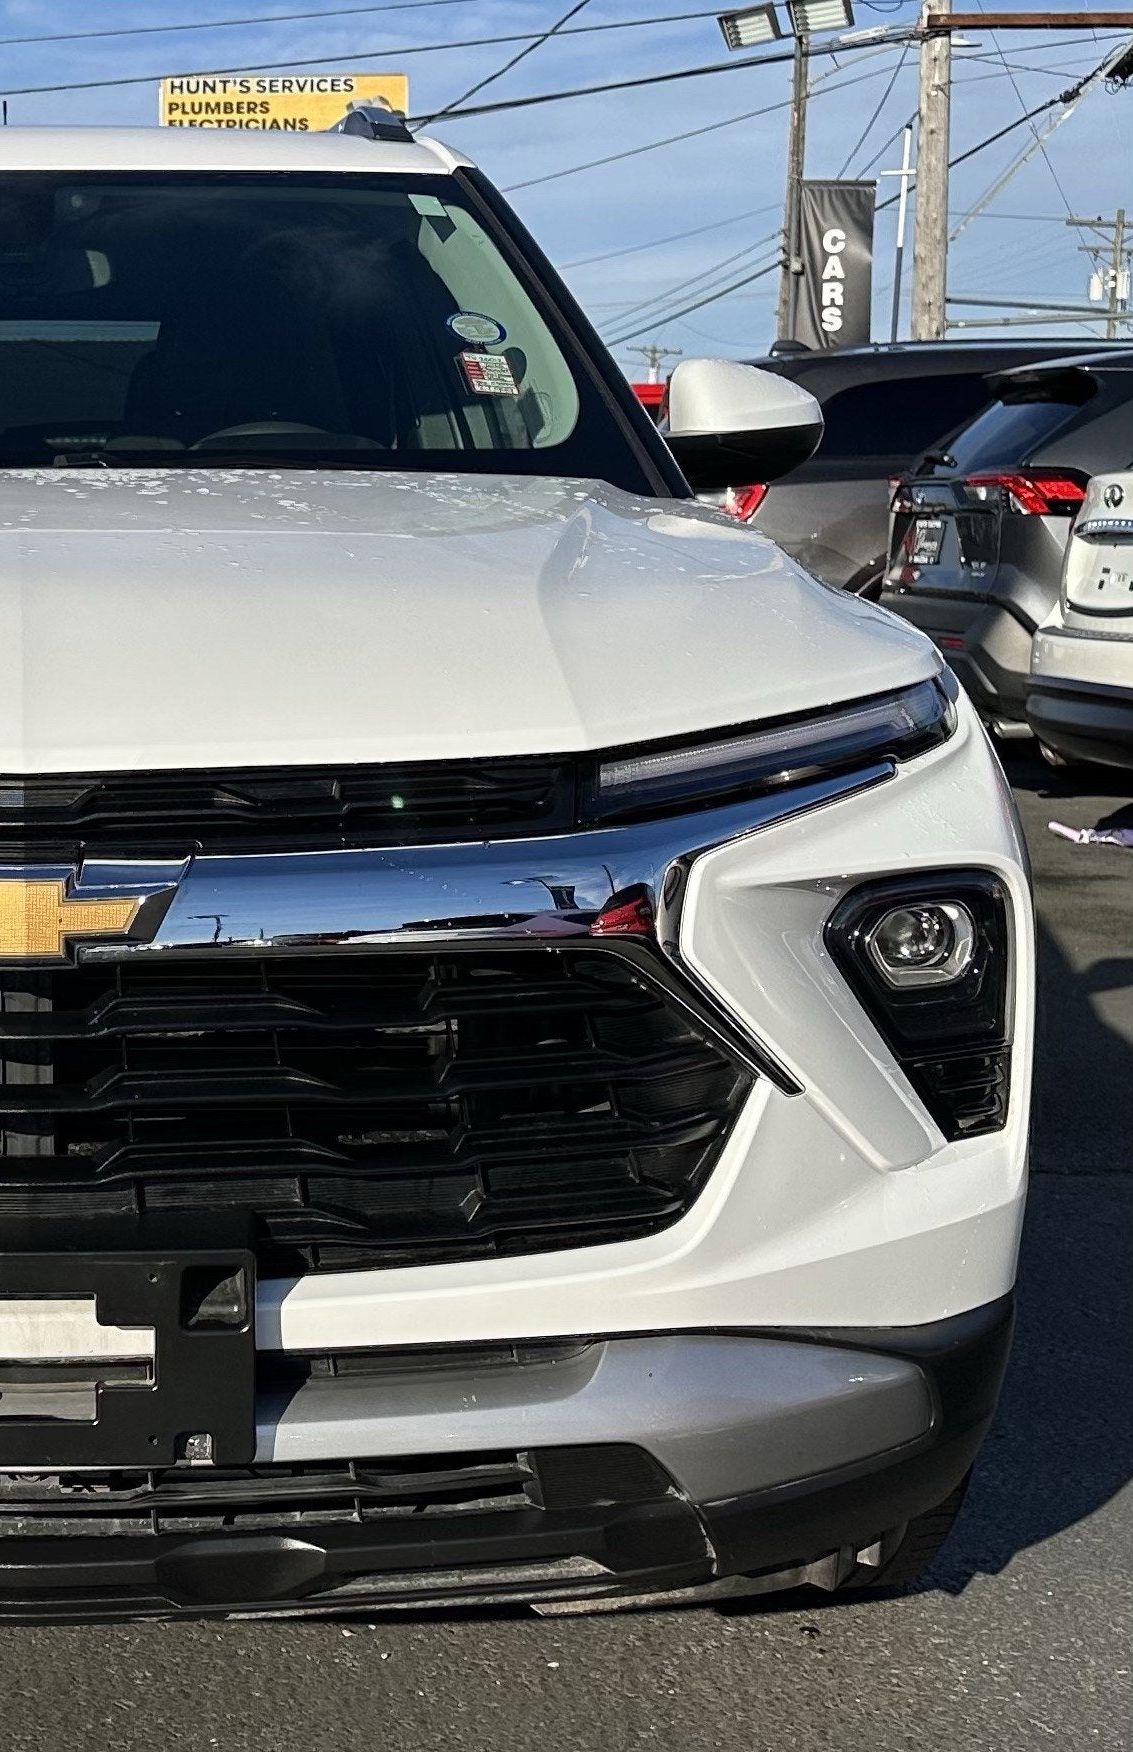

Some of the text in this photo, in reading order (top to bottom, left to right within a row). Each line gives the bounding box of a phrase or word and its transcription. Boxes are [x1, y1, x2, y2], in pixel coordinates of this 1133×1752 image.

[170, 78, 354, 94] HUNT'S SERVICES
[168, 101, 270, 115] PLUMBERS
[821, 228, 846, 332] CARS
